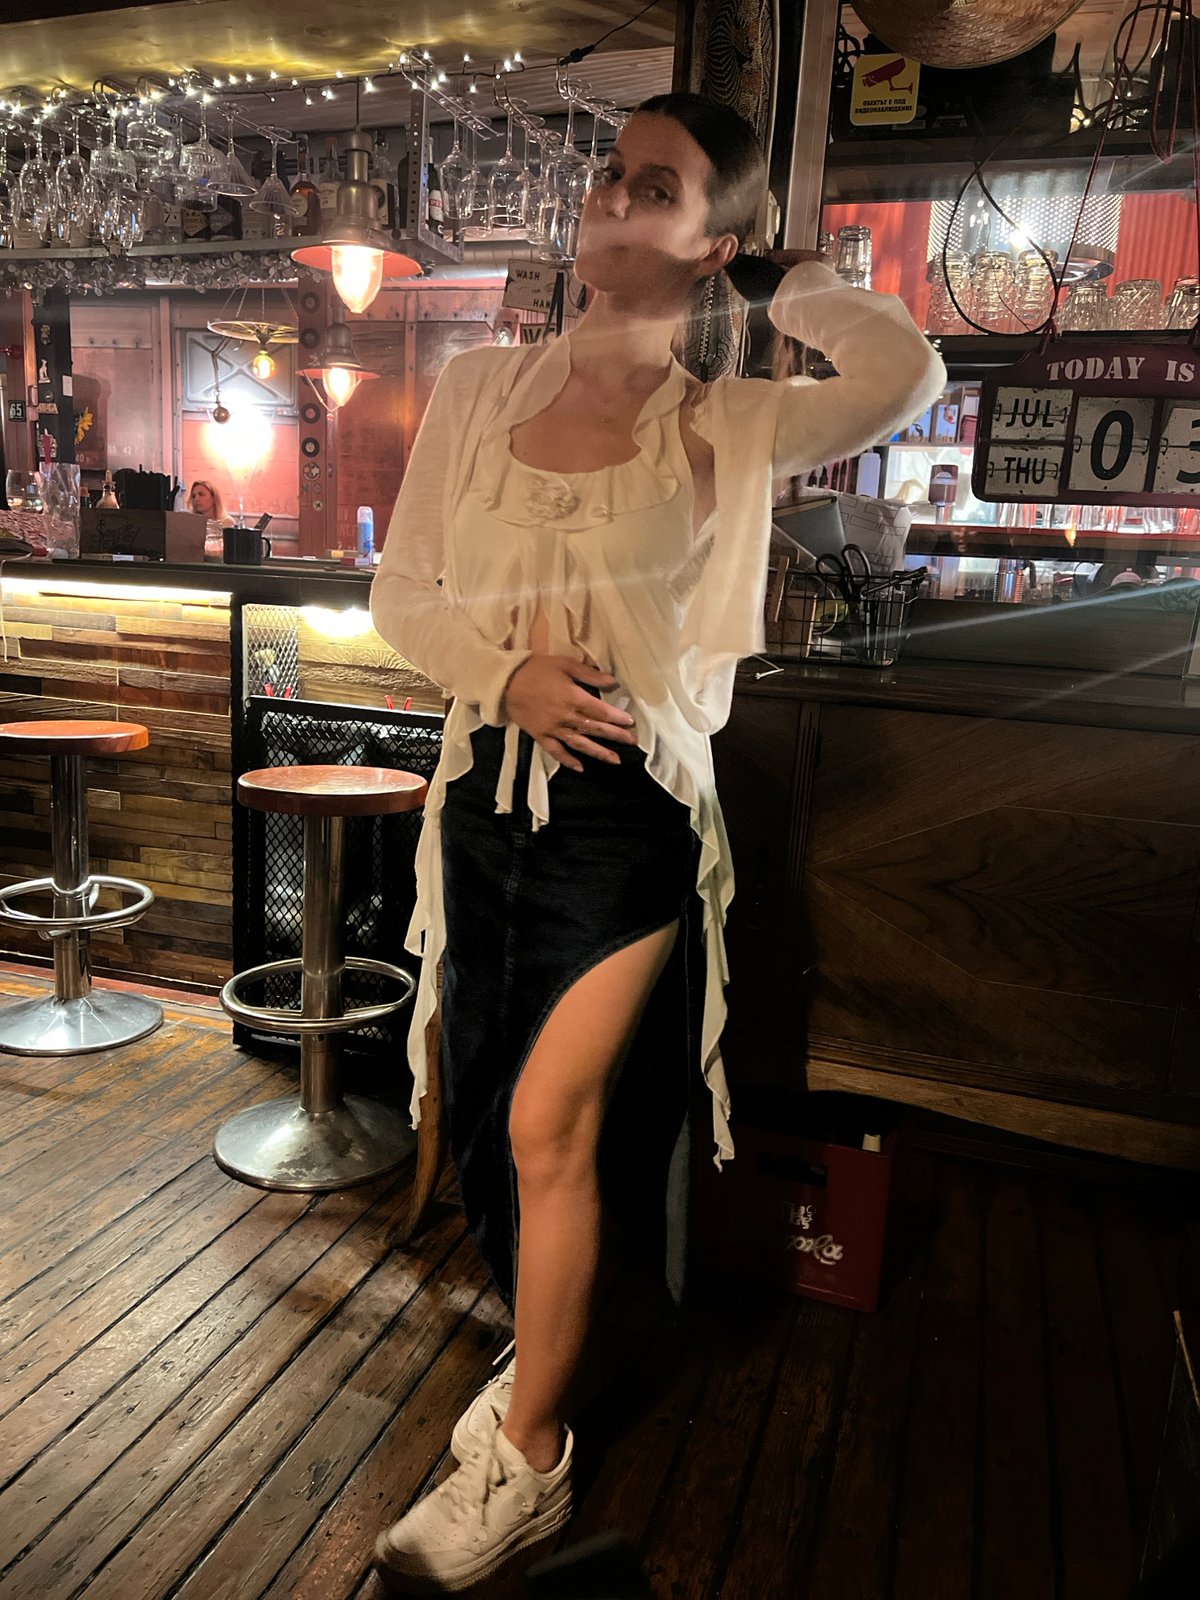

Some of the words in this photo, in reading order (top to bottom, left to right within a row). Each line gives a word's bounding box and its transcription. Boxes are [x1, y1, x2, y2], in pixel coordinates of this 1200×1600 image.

[516, 269, 540, 280] WASH
[532, 298, 551, 308] HAN
[1046, 356, 1145, 381] TODAY
[1164, 360, 1196, 383] IS
[9, 402, 23, 418] 65
[1005, 398, 1055, 428] JUL
[1003, 457, 1047, 484] THU
